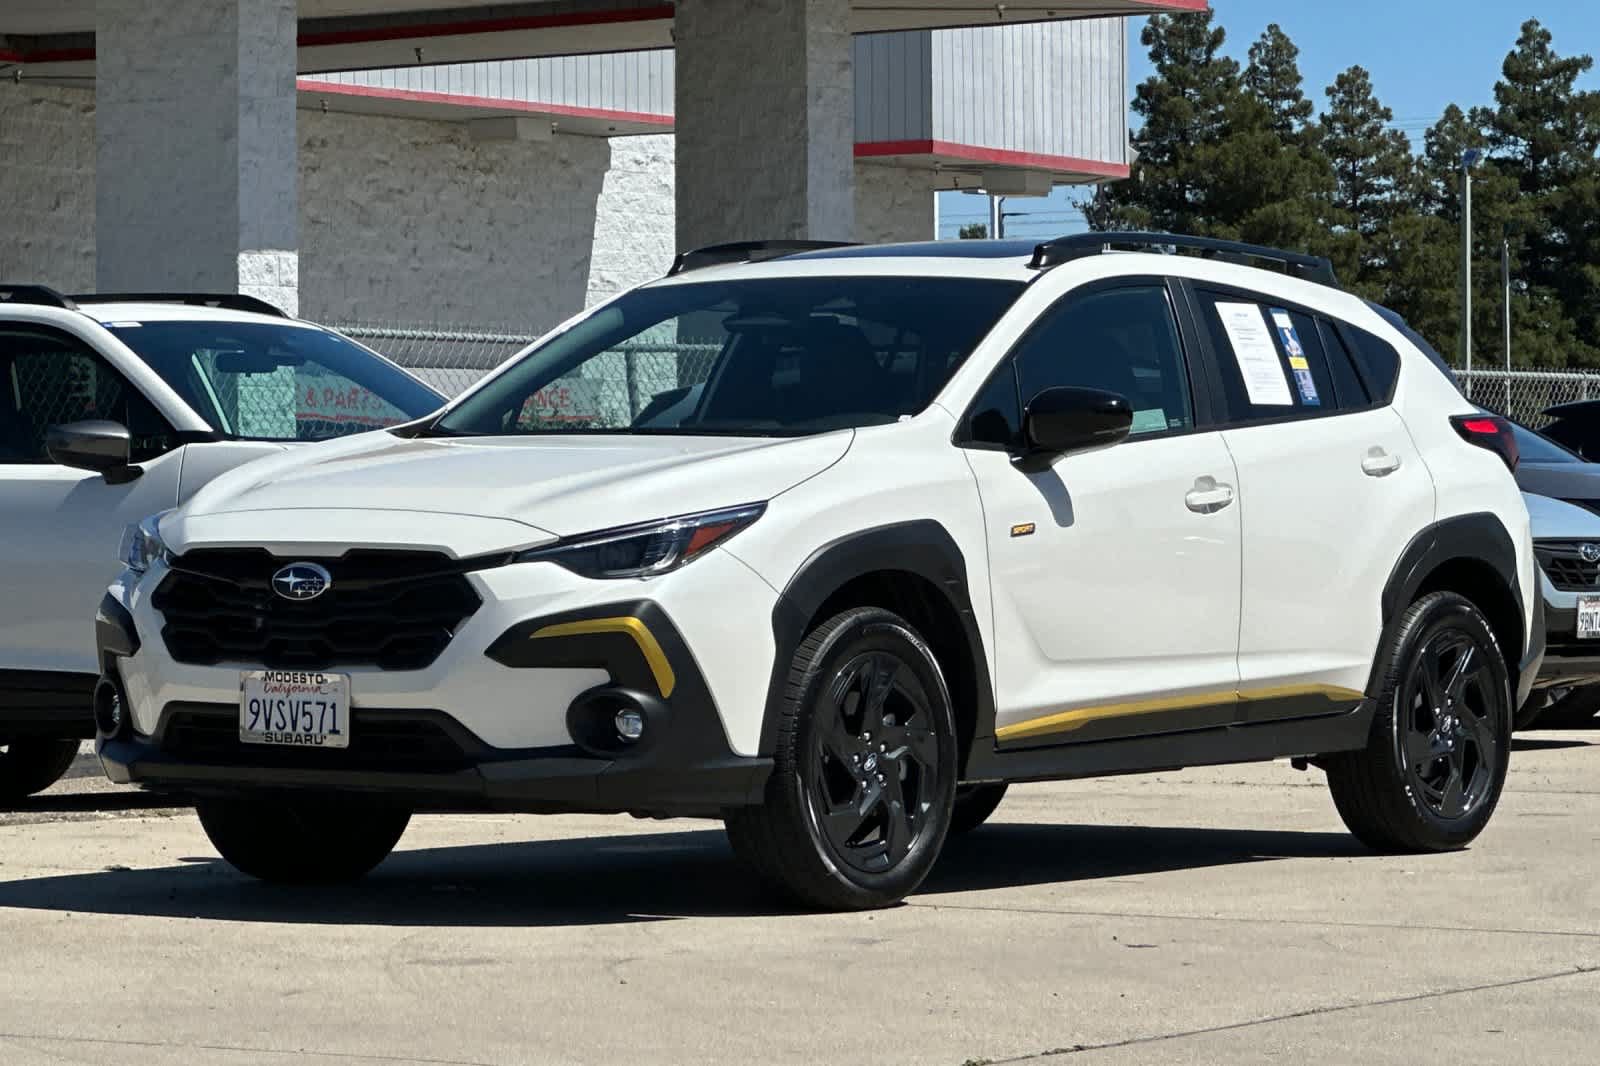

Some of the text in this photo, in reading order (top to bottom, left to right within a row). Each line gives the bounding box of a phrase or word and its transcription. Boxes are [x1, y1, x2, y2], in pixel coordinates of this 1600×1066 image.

[264, 671, 324, 684] MODESTO
[263, 683, 322, 698] California
[248, 698, 340, 735] 9VSV571
